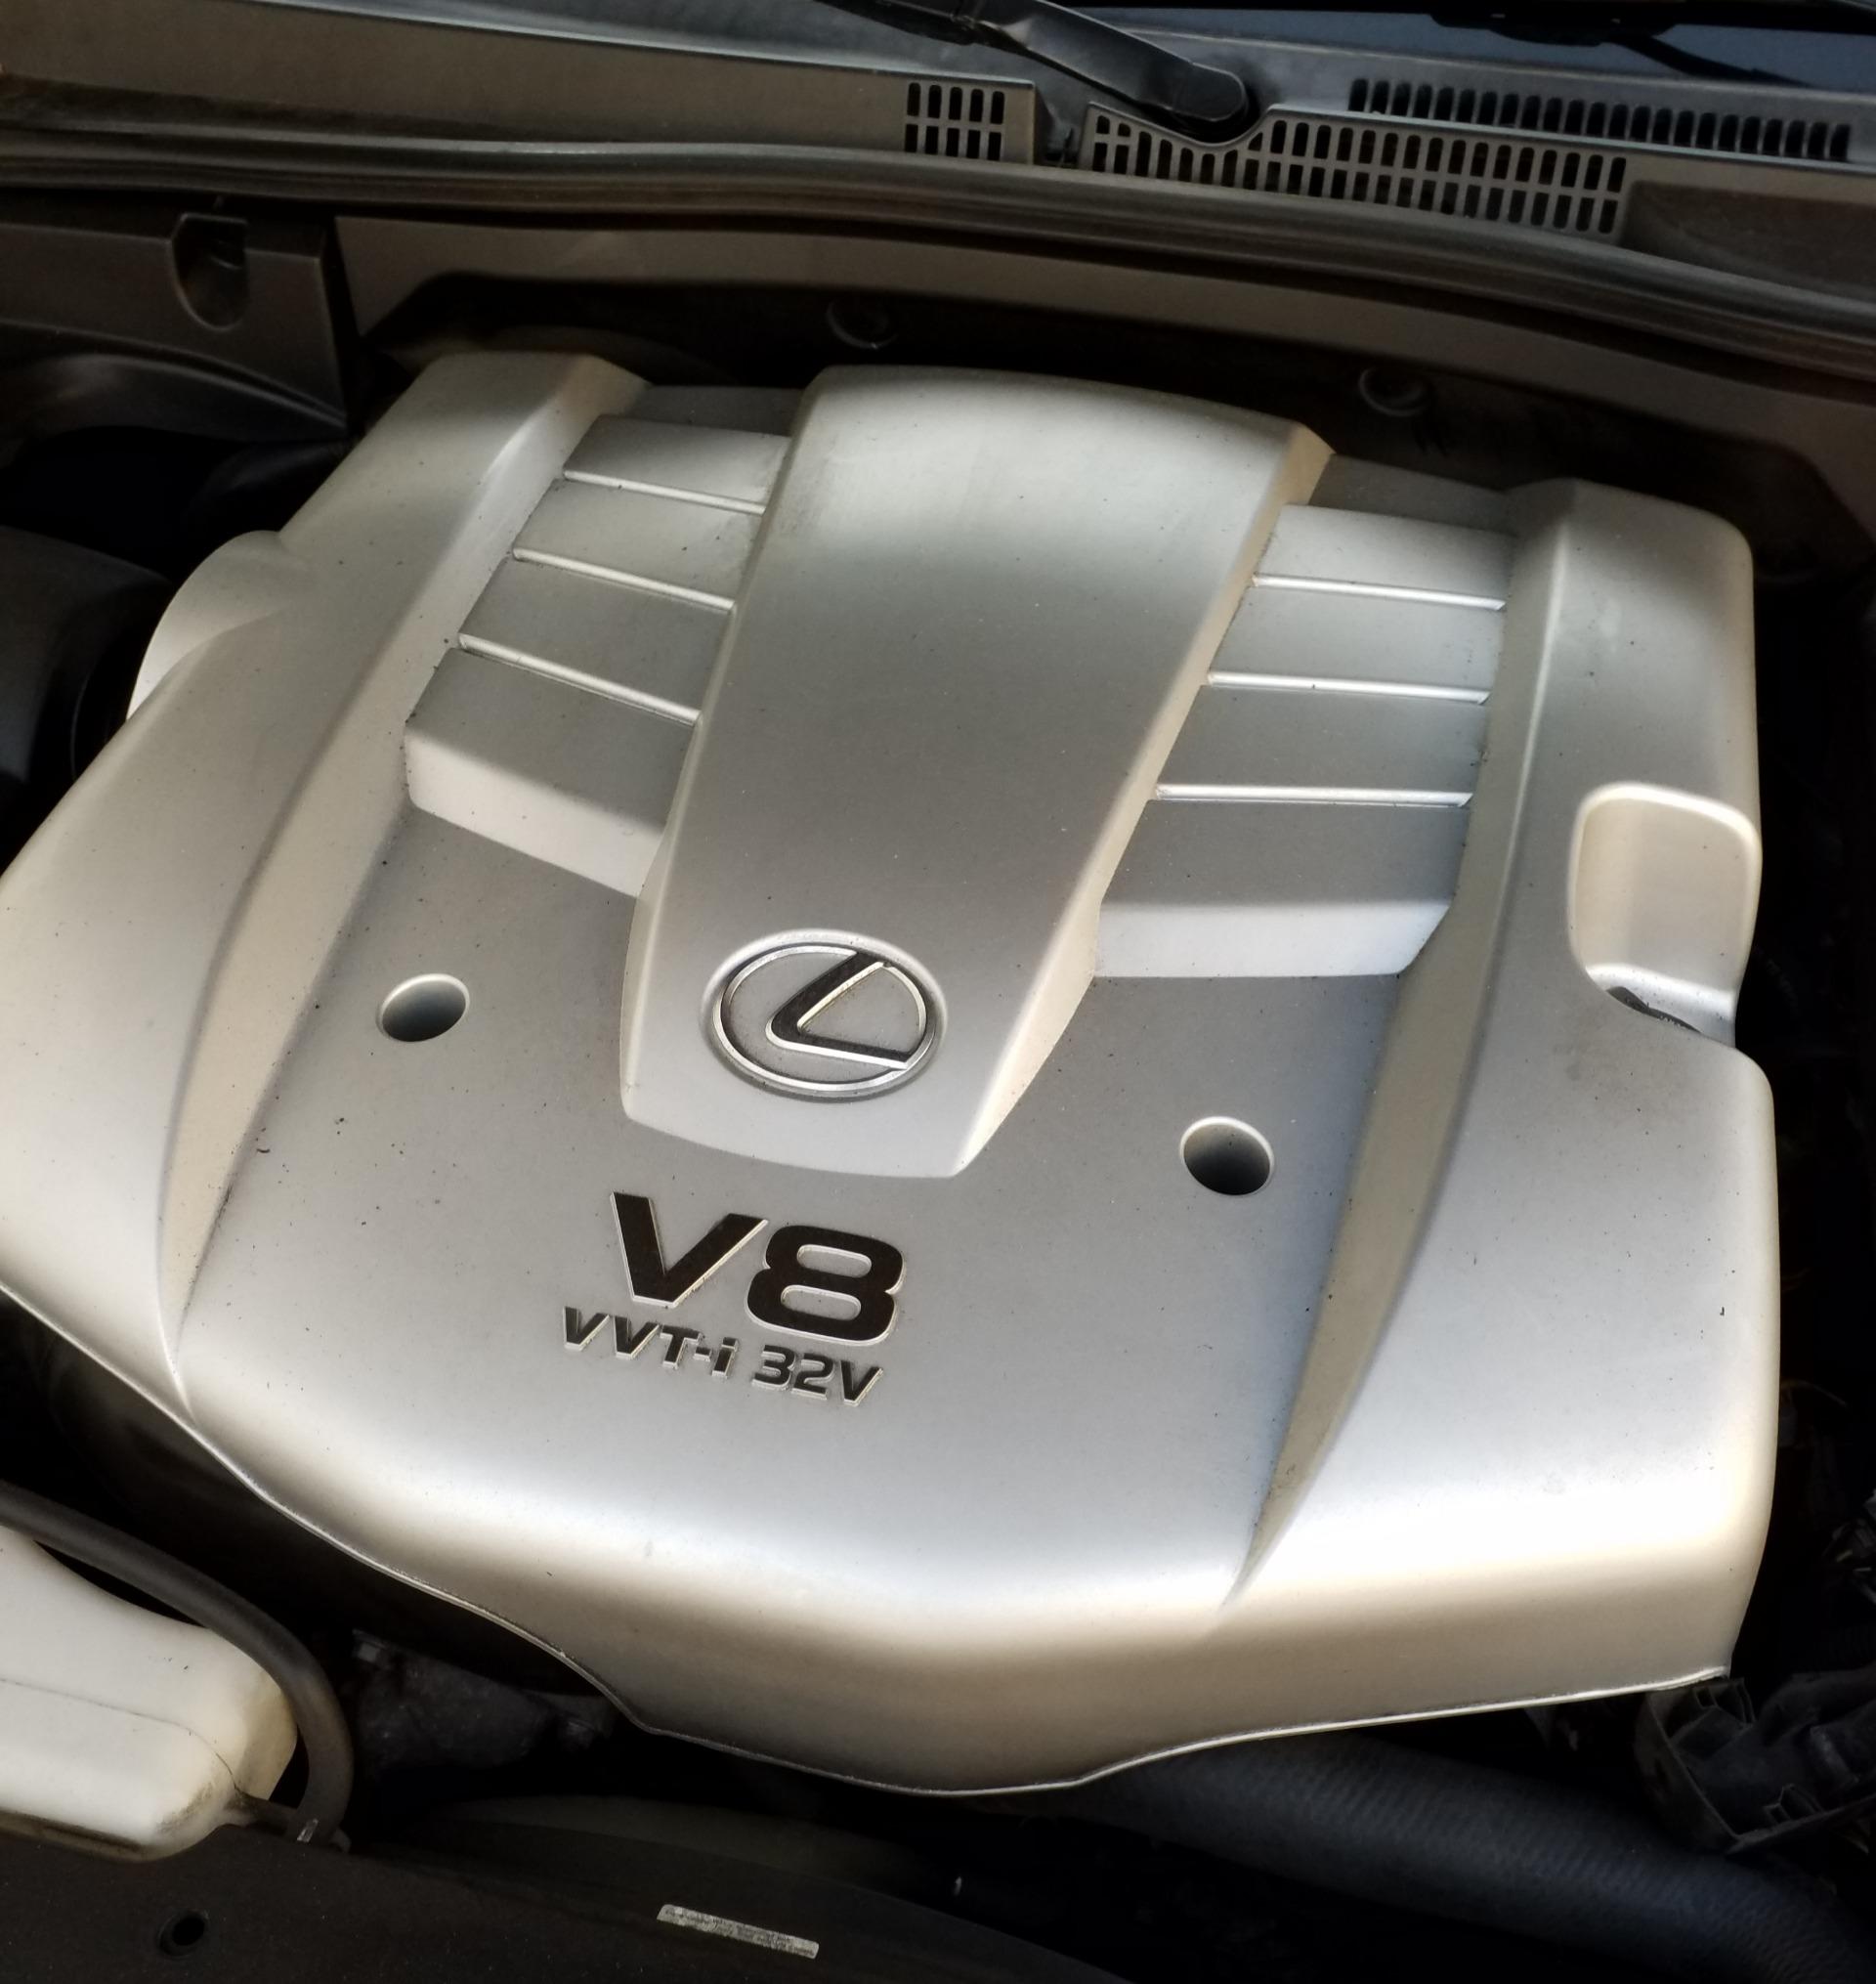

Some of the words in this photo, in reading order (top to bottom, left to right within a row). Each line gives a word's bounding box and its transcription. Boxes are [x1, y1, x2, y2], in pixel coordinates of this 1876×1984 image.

[610, 1191, 906, 1346] V8
[563, 1307, 738, 1379] VVT-i
[751, 1344, 883, 1406] 32V
